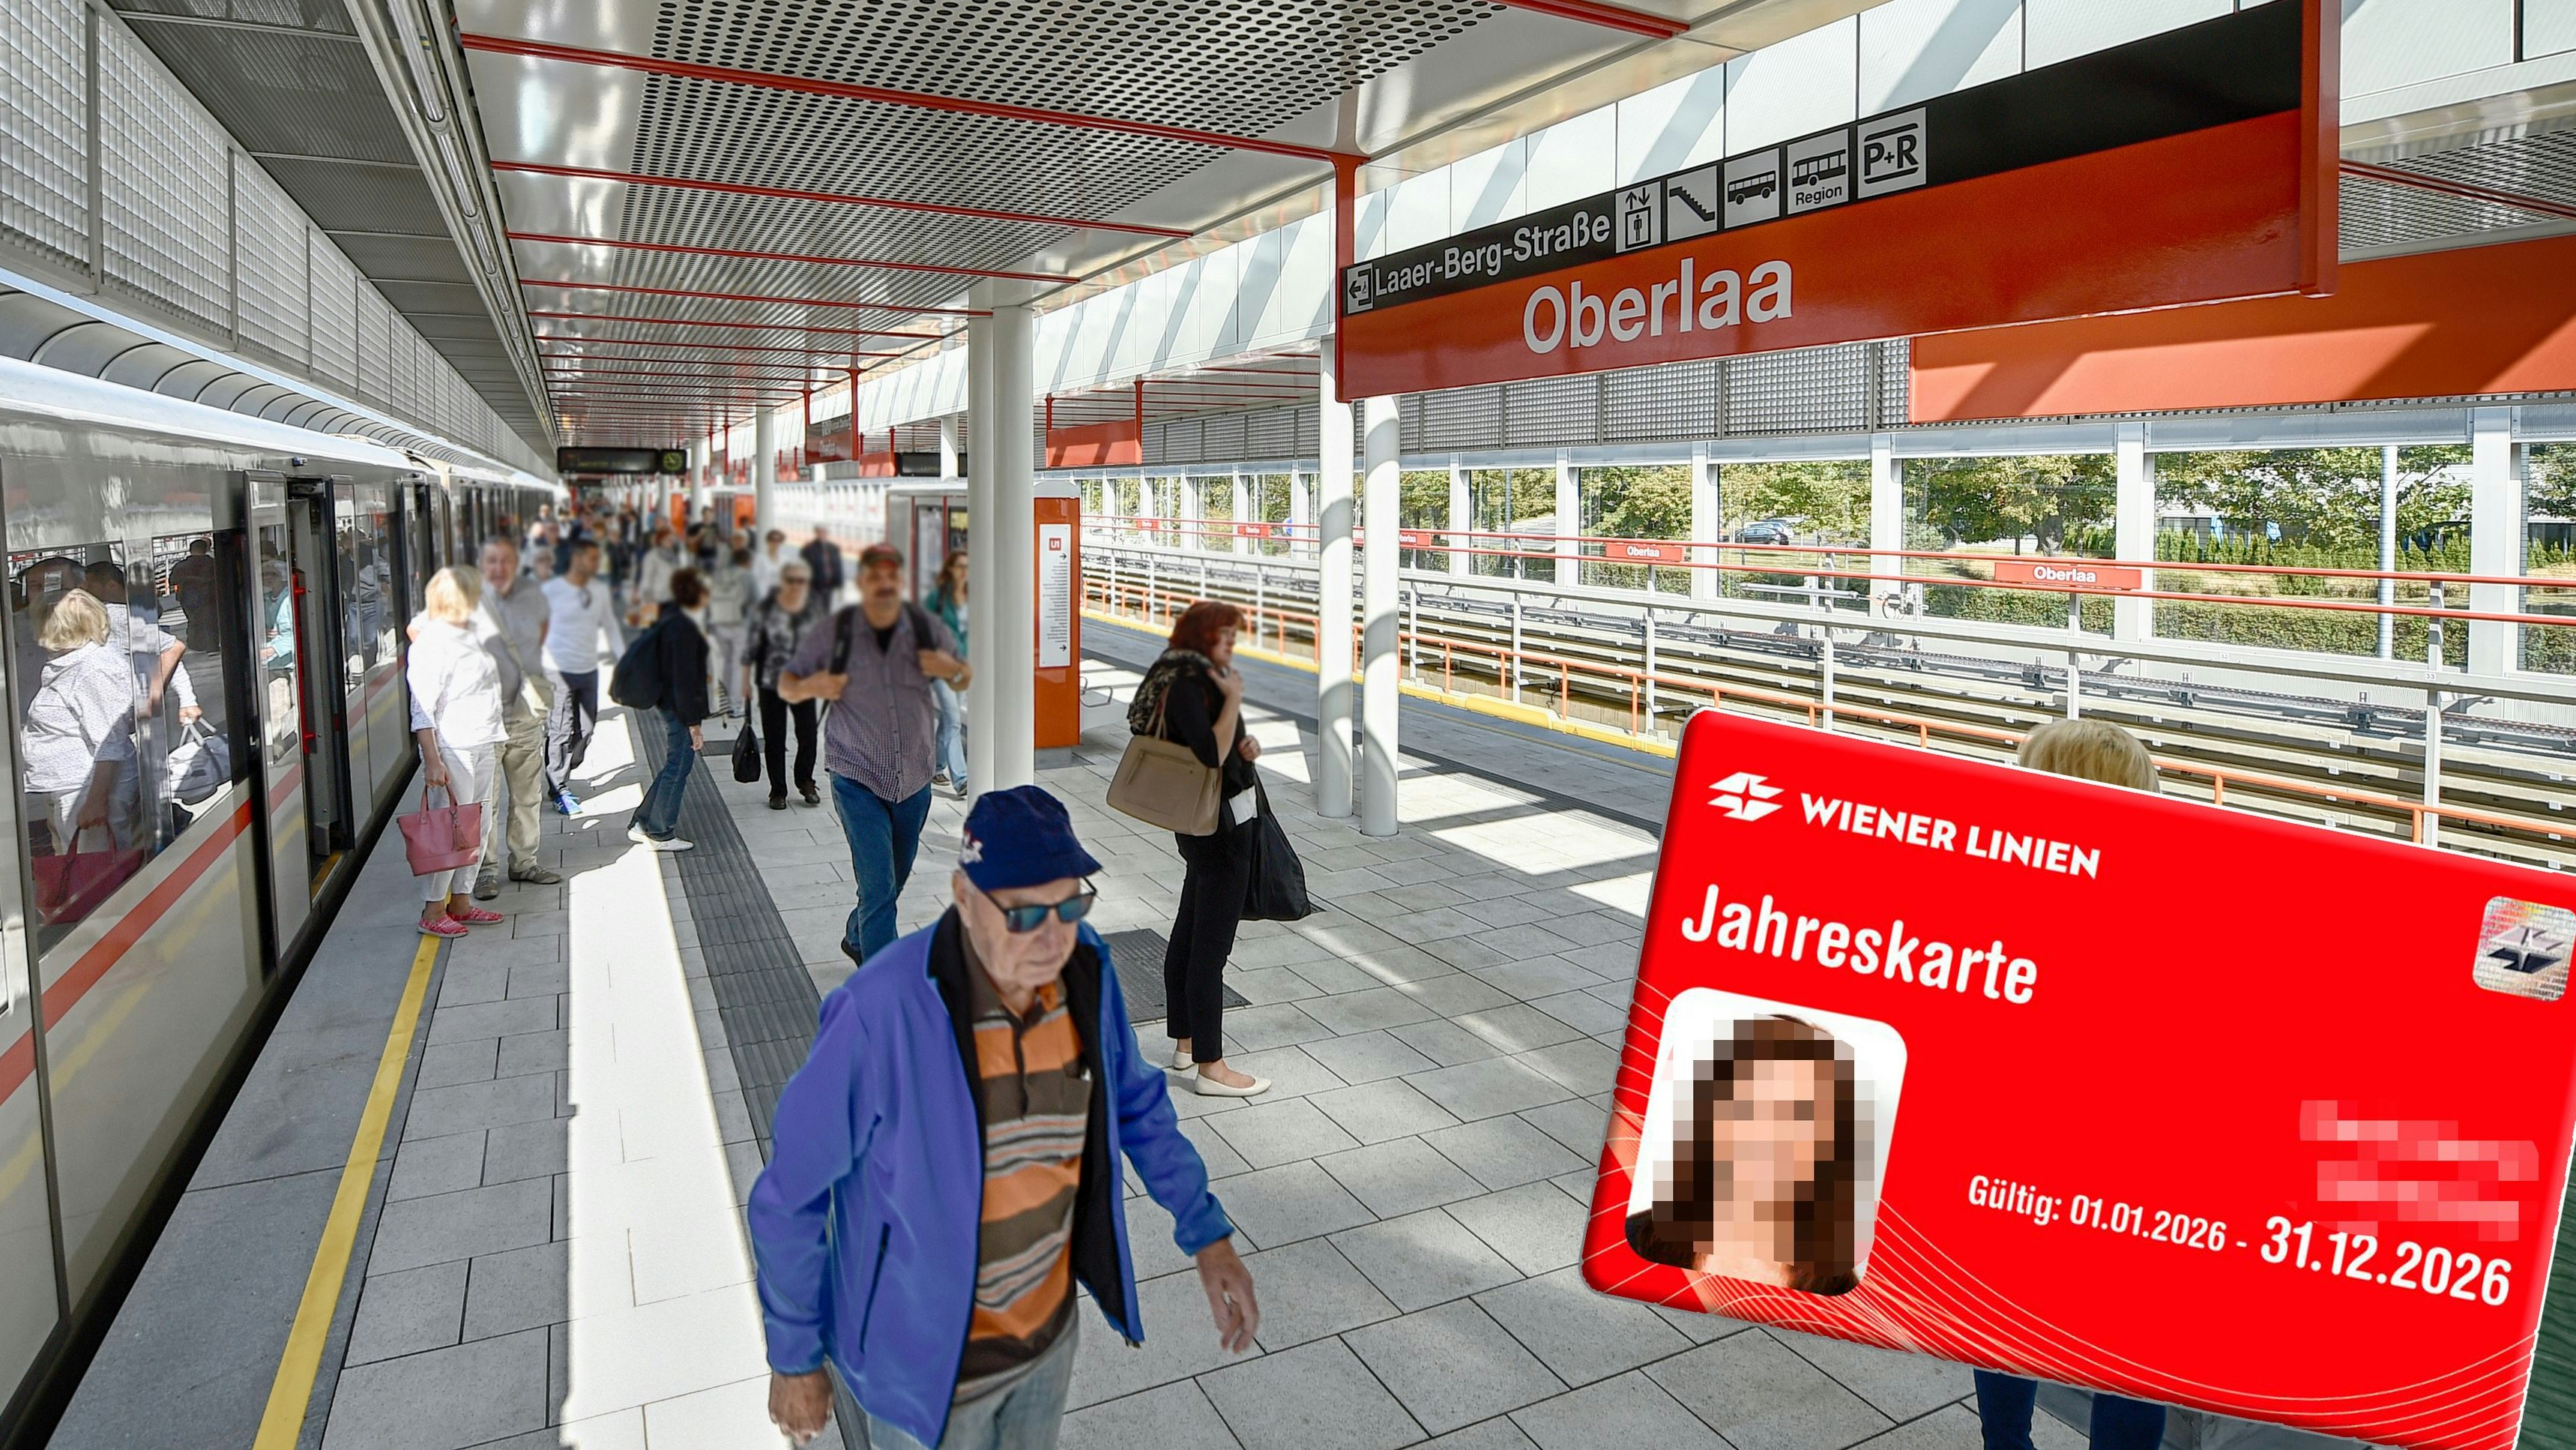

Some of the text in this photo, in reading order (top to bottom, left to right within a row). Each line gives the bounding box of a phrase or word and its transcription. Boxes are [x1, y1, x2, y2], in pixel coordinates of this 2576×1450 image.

[1864, 134, 1919, 177] P+R
[1796, 186, 1843, 206] Region
[1375, 211, 1611, 297] Laaer-Berg-Straße
[1523, 257, 1793, 355] Oberlaa
[1626, 545, 1660, 558] Oberlaa
[2033, 565, 2096, 583] Oberlaa
